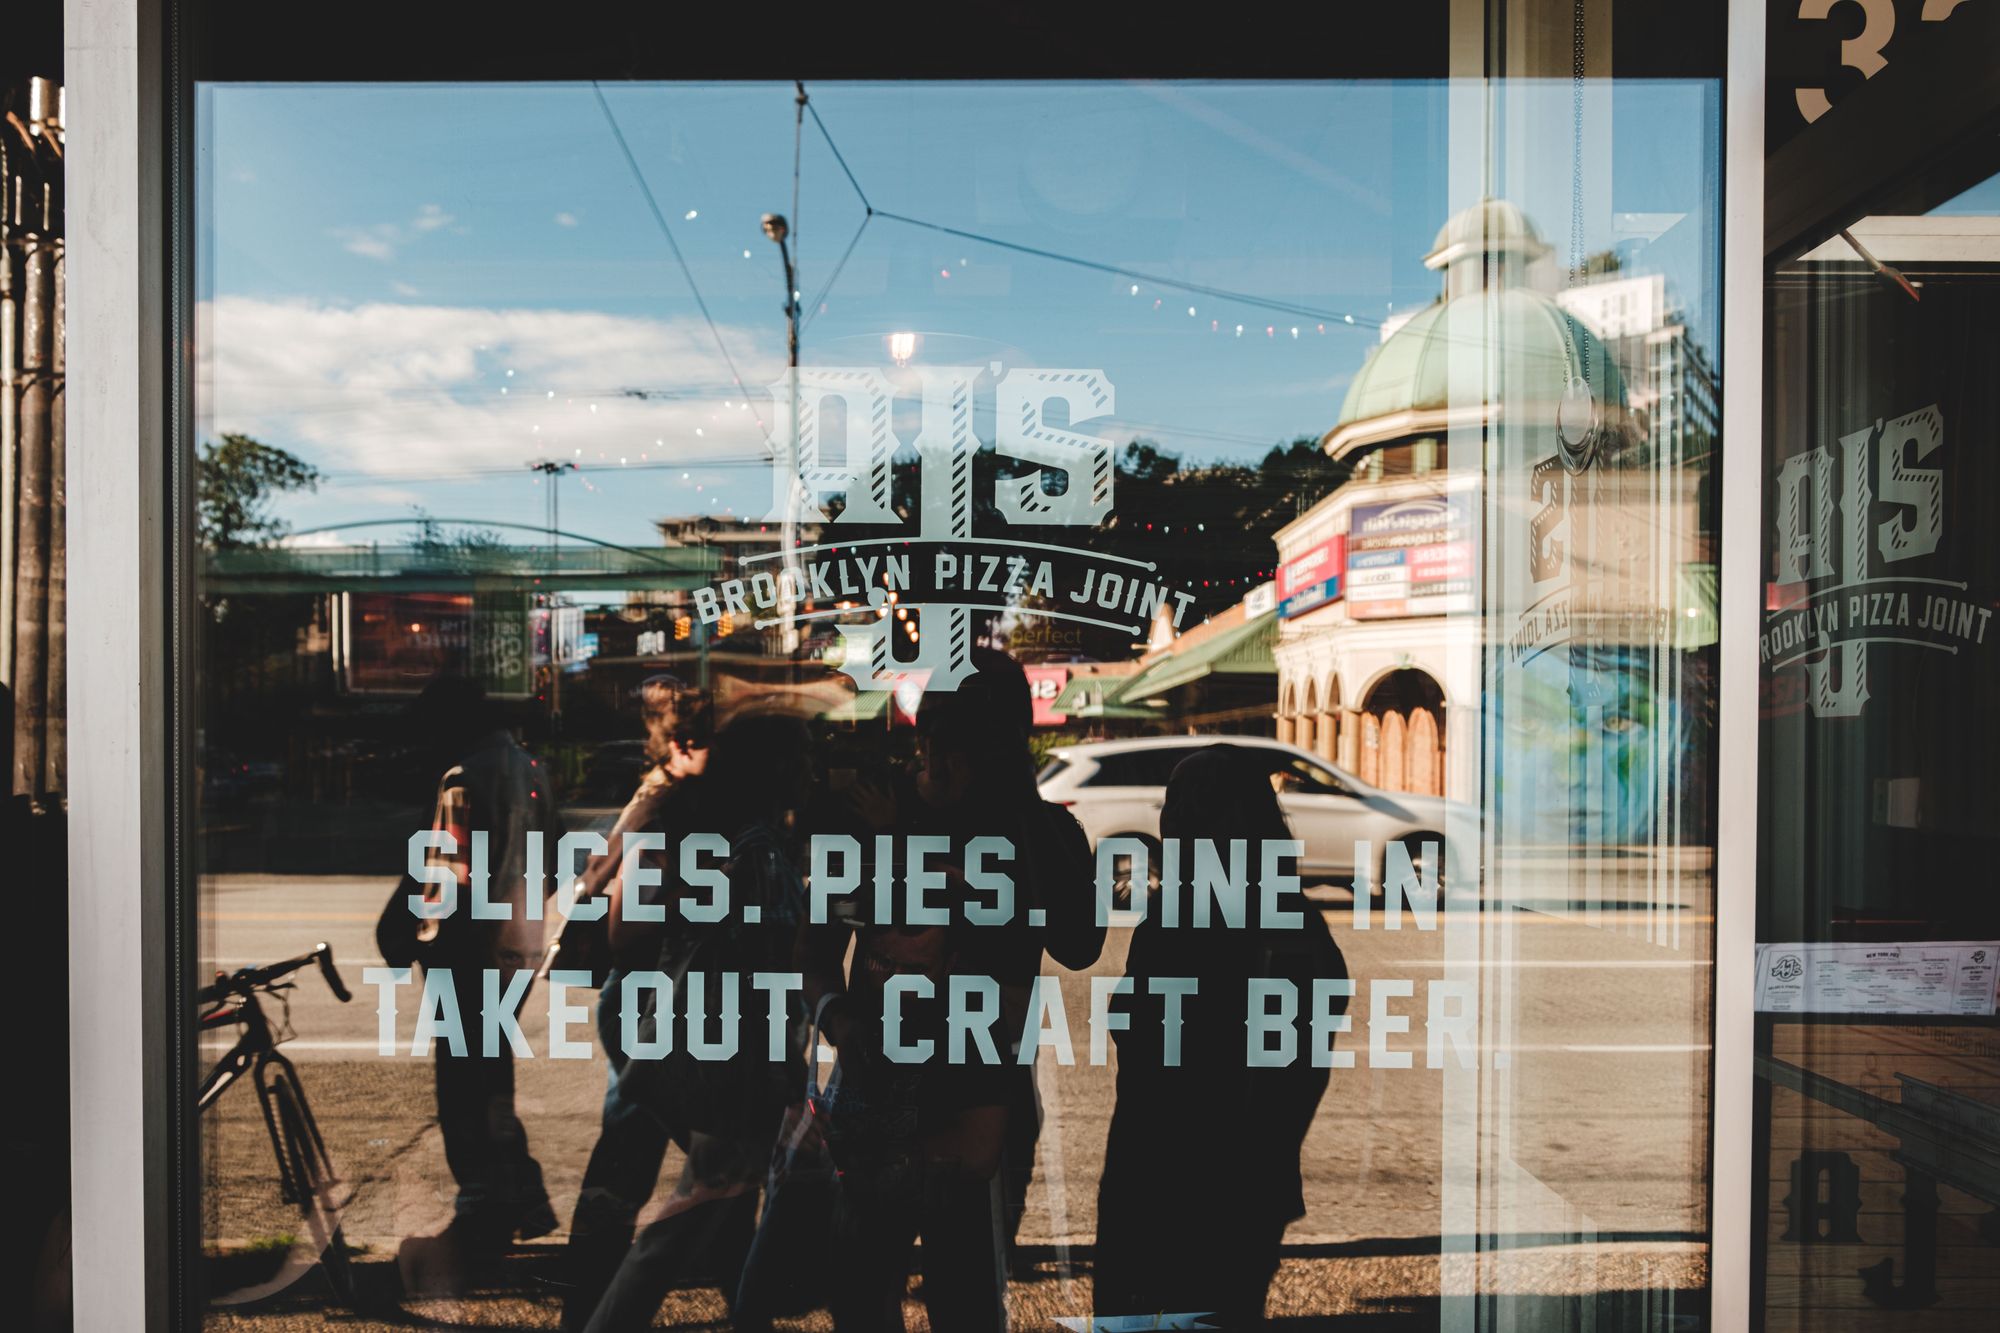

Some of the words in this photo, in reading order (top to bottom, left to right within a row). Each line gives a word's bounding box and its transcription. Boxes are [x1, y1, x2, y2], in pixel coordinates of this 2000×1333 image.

[693, 554, 911, 625] BROOKLYN
[935, 553, 1054, 599] PIZZA
[1069, 568, 1197, 629] JOINT
[1760, 599, 1839, 664] ROOKLYN
[1849, 593, 1910, 628] PIZZA
[1918, 595, 1992, 645] JOINT
[1010, 623, 1081, 647] perfect
[407, 830, 761, 925] SLICES.
[807, 833, 1046, 926] PIES.
[1093, 837, 1305, 930] DINE
[1351, 840, 1441, 931] IN
[881, 973, 1199, 1066] CRAFT
[1245, 977, 1512, 1071] BEER.
